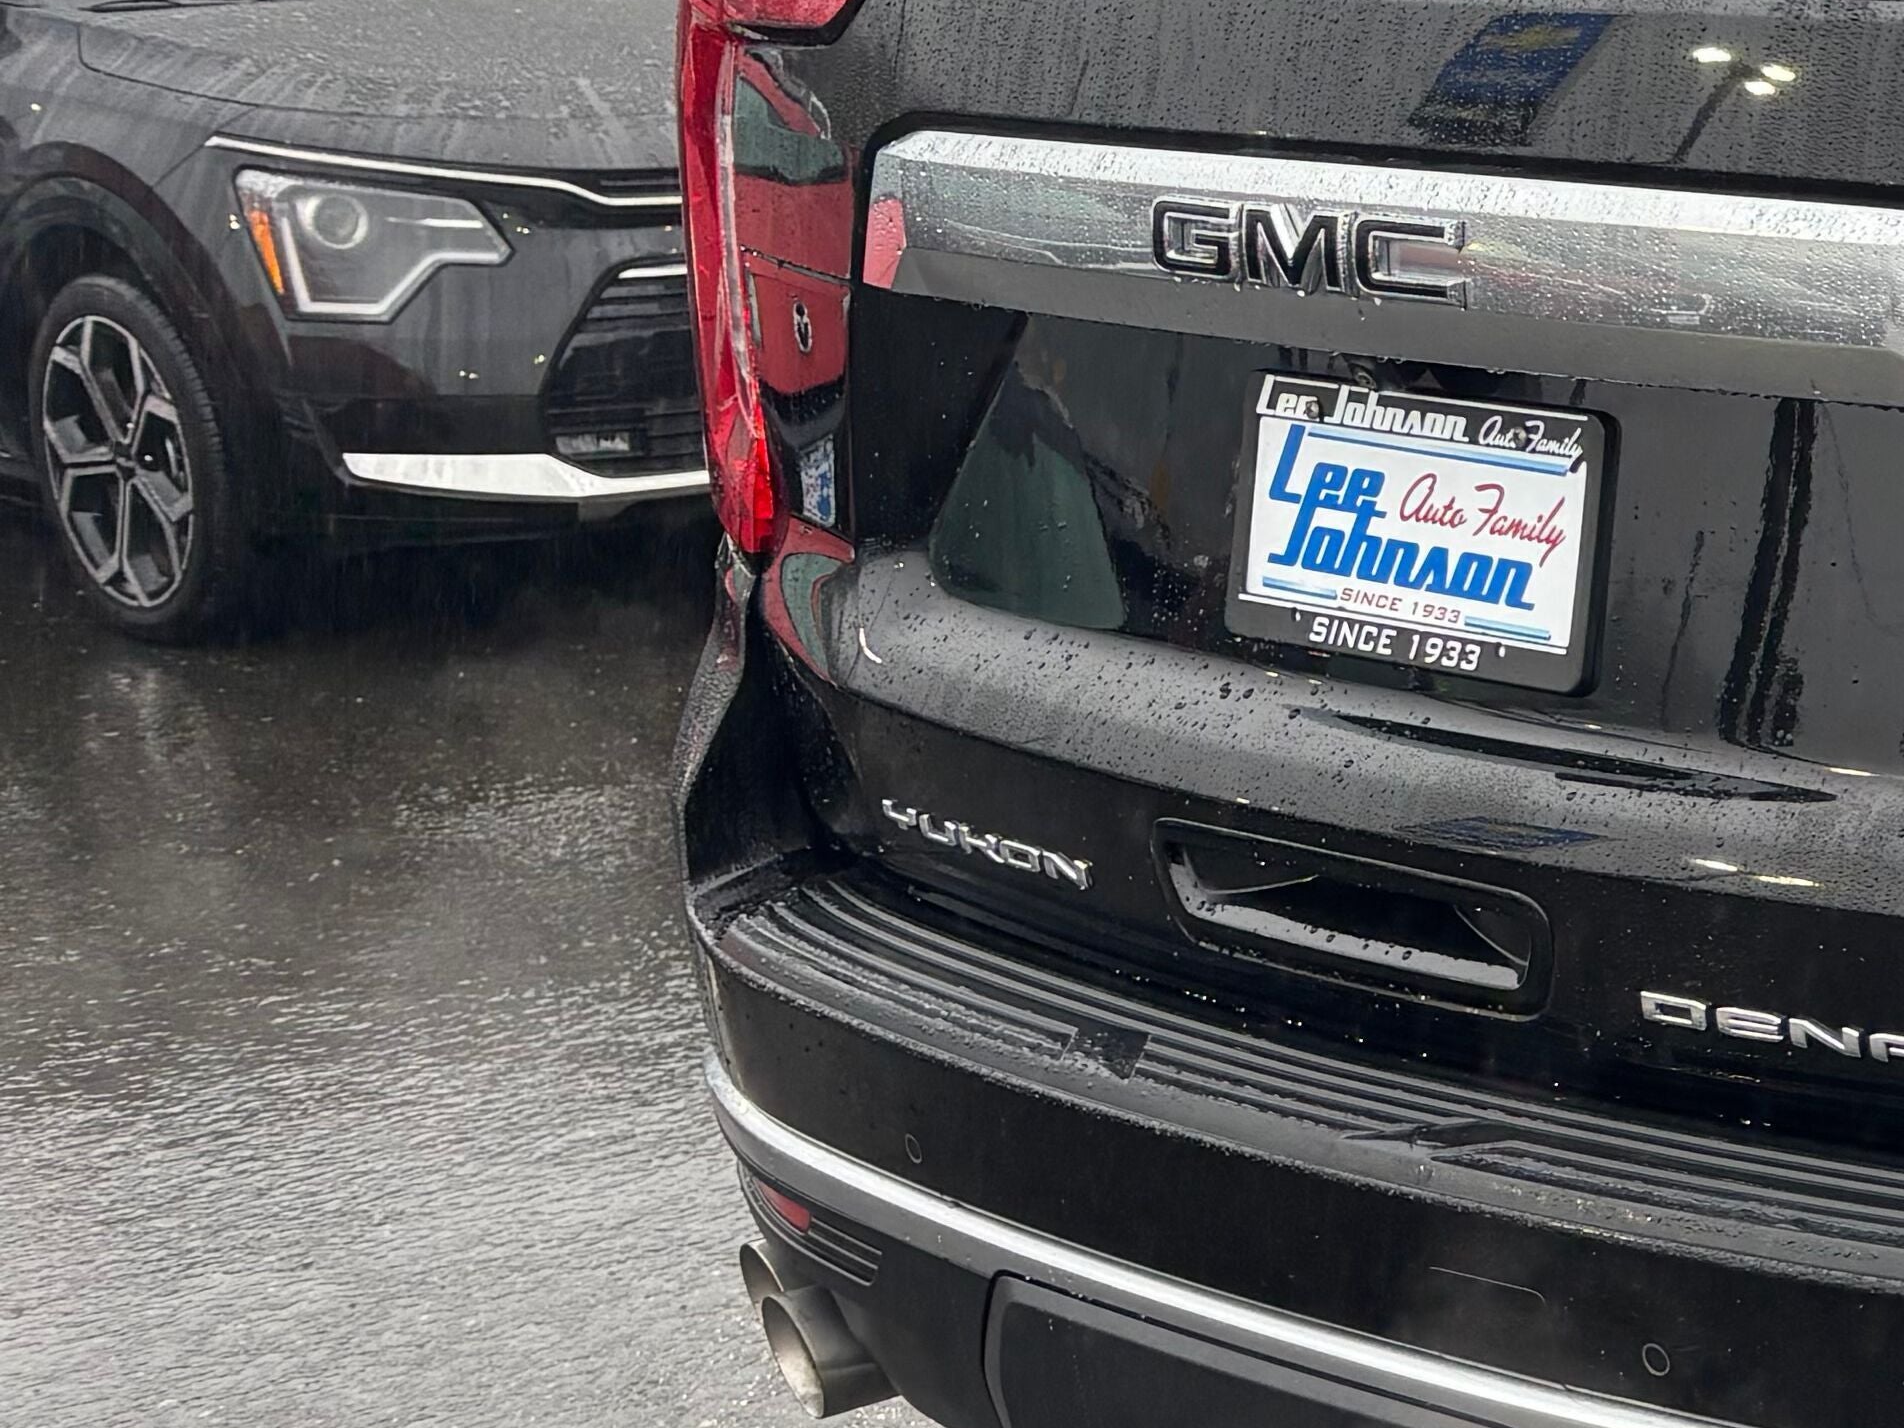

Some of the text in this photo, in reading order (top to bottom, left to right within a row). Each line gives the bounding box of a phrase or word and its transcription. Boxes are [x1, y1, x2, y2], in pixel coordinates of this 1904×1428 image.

[1152, 193, 1467, 310] GMC
[1323, 384, 1469, 443] Johnson
[1478, 415, 1526, 449] Aut
[1525, 420, 1583, 473] Family
[1269, 424, 1566, 568] Lee Auto Family
[1267, 494, 1534, 611] Johnson
[1308, 616, 1482, 672] SINCE 1933
[1340, 587, 1462, 624] SINCE 1933
[881, 798, 1093, 891] YUKON
